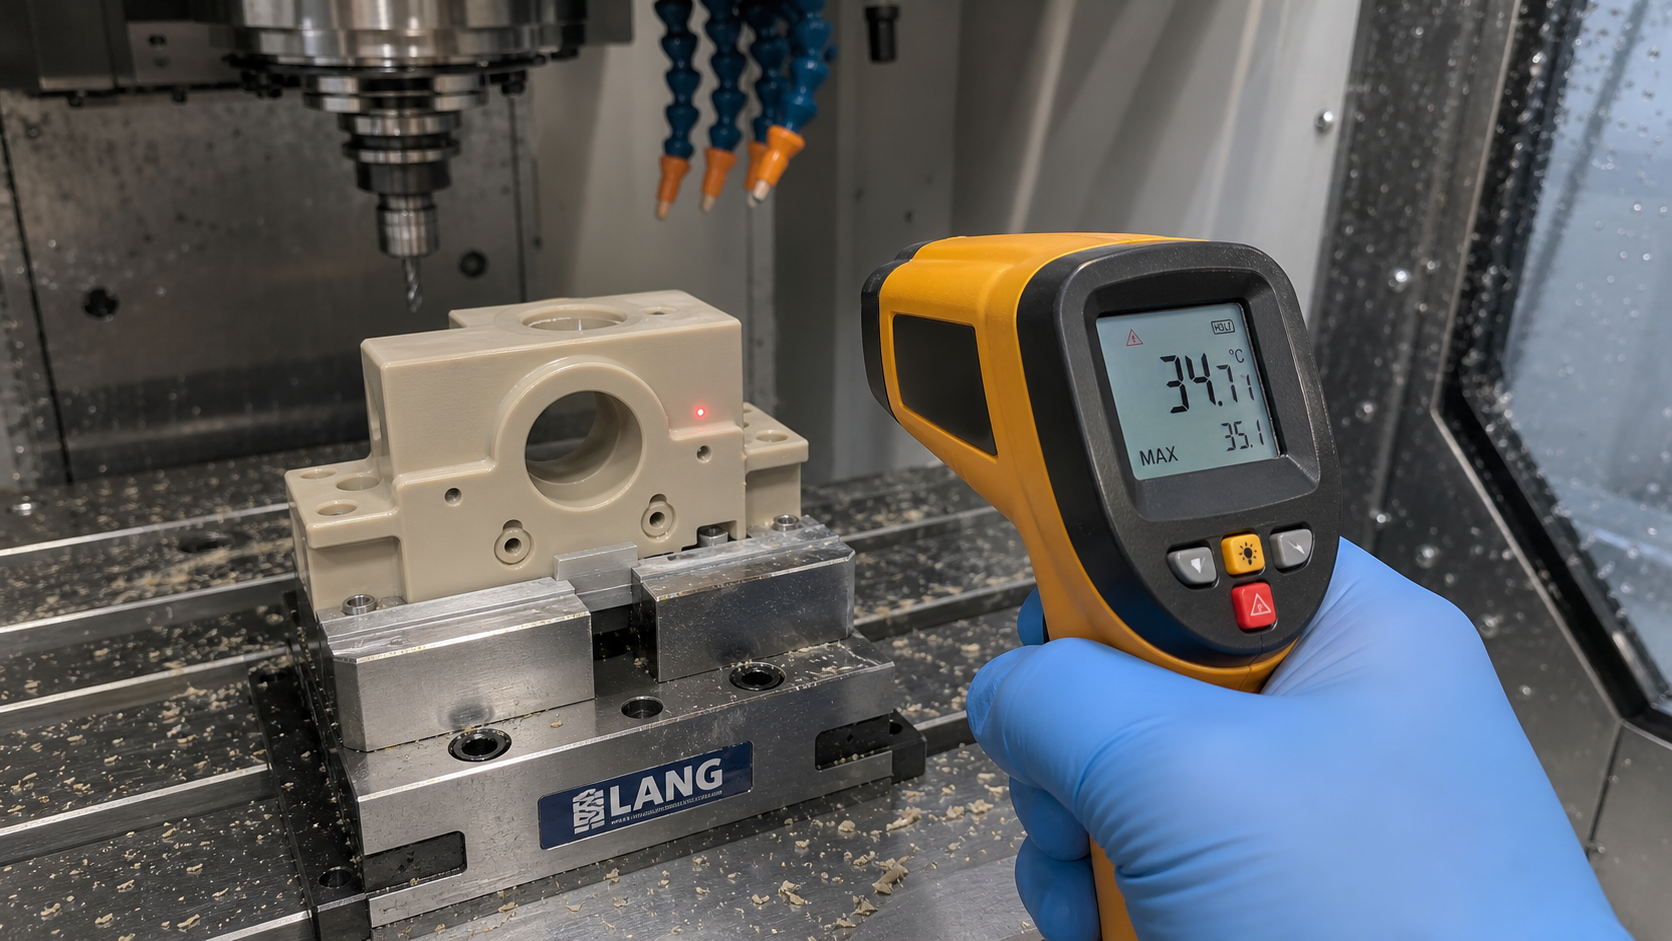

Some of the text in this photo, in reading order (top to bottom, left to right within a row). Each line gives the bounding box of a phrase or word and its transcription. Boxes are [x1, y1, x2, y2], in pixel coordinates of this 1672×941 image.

[1228, 349, 1245, 363] °C
[1221, 419, 1264, 452] 35.1
[1139, 446, 1179, 466] MAX
[610, 758, 723, 817] LANG
